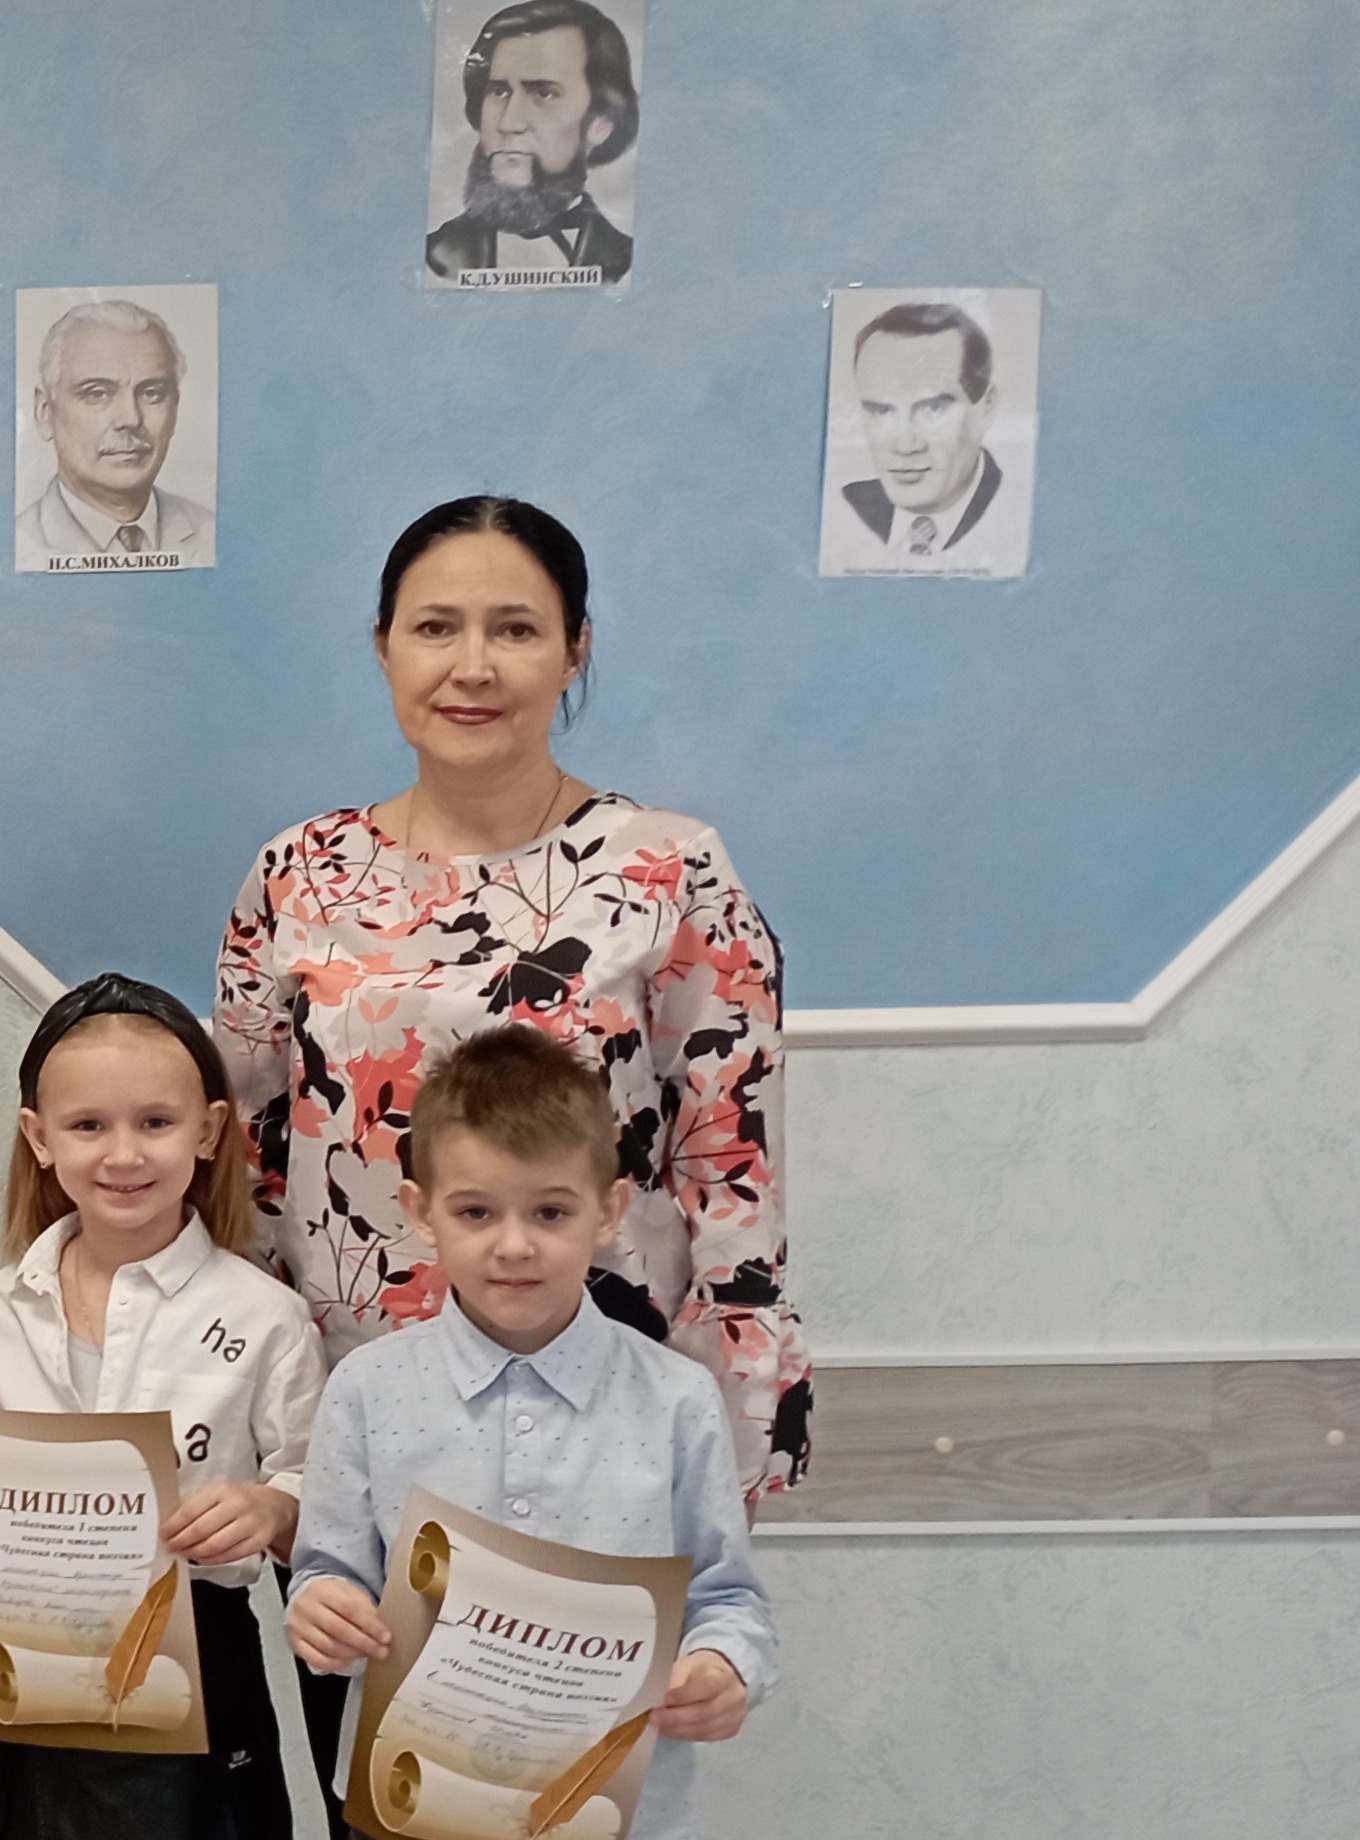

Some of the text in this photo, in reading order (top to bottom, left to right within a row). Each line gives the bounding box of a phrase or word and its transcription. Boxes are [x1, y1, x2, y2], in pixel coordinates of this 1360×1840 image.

[460, 266, 598, 287] К.Д.УШИНСКИЙ
[49, 555, 179, 570] Н.С.МИХАЛКОВ
[201, 1318, 246, 1363] ha
[176, 1423, 211, 1469] a
[456, 1603, 645, 1662] ДИПЛОМ
